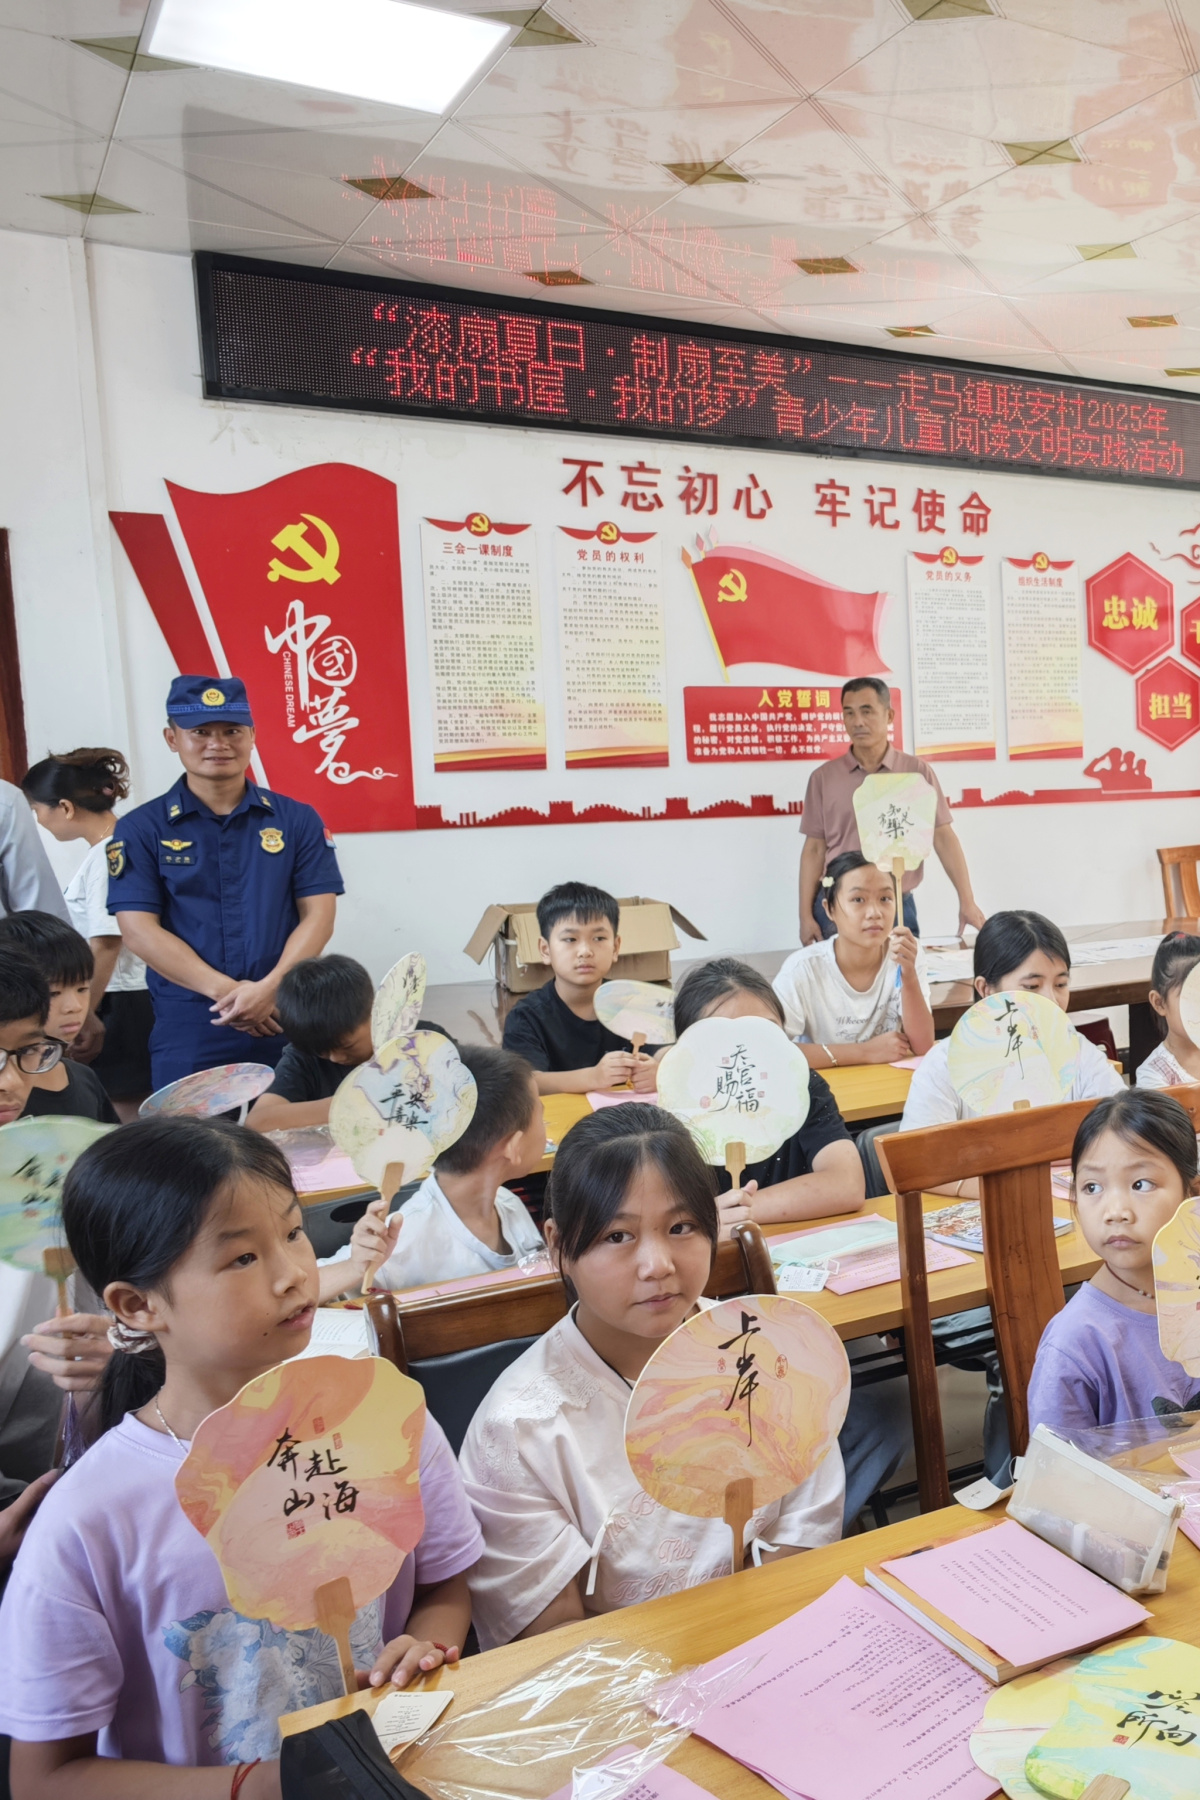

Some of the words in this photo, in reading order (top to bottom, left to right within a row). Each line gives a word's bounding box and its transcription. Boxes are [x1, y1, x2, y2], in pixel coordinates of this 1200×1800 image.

[561, 456, 774, 521] 不忘初心
[814, 478, 993, 537] 牢记使命
[442, 542, 514, 558] 三会一课制度
[576, 549, 646, 564] 党员的权利
[925, 569, 973, 583] 党员的义务
[1018, 575, 1064, 588] 组织生活制度
[1102, 594, 1160, 631] 忠诚
[282, 650, 295, 693] CHINESE
[758, 689, 831, 709] 入党誓词
[1149, 692, 1193, 721] 担当
[285, 694, 297, 728] DREAM
[708, 712, 844, 722] 我志愿加入中国共产党，拥护党的纲
[692, 724, 847, 734] 程，履行党员义务，执行党的决定，严守党
